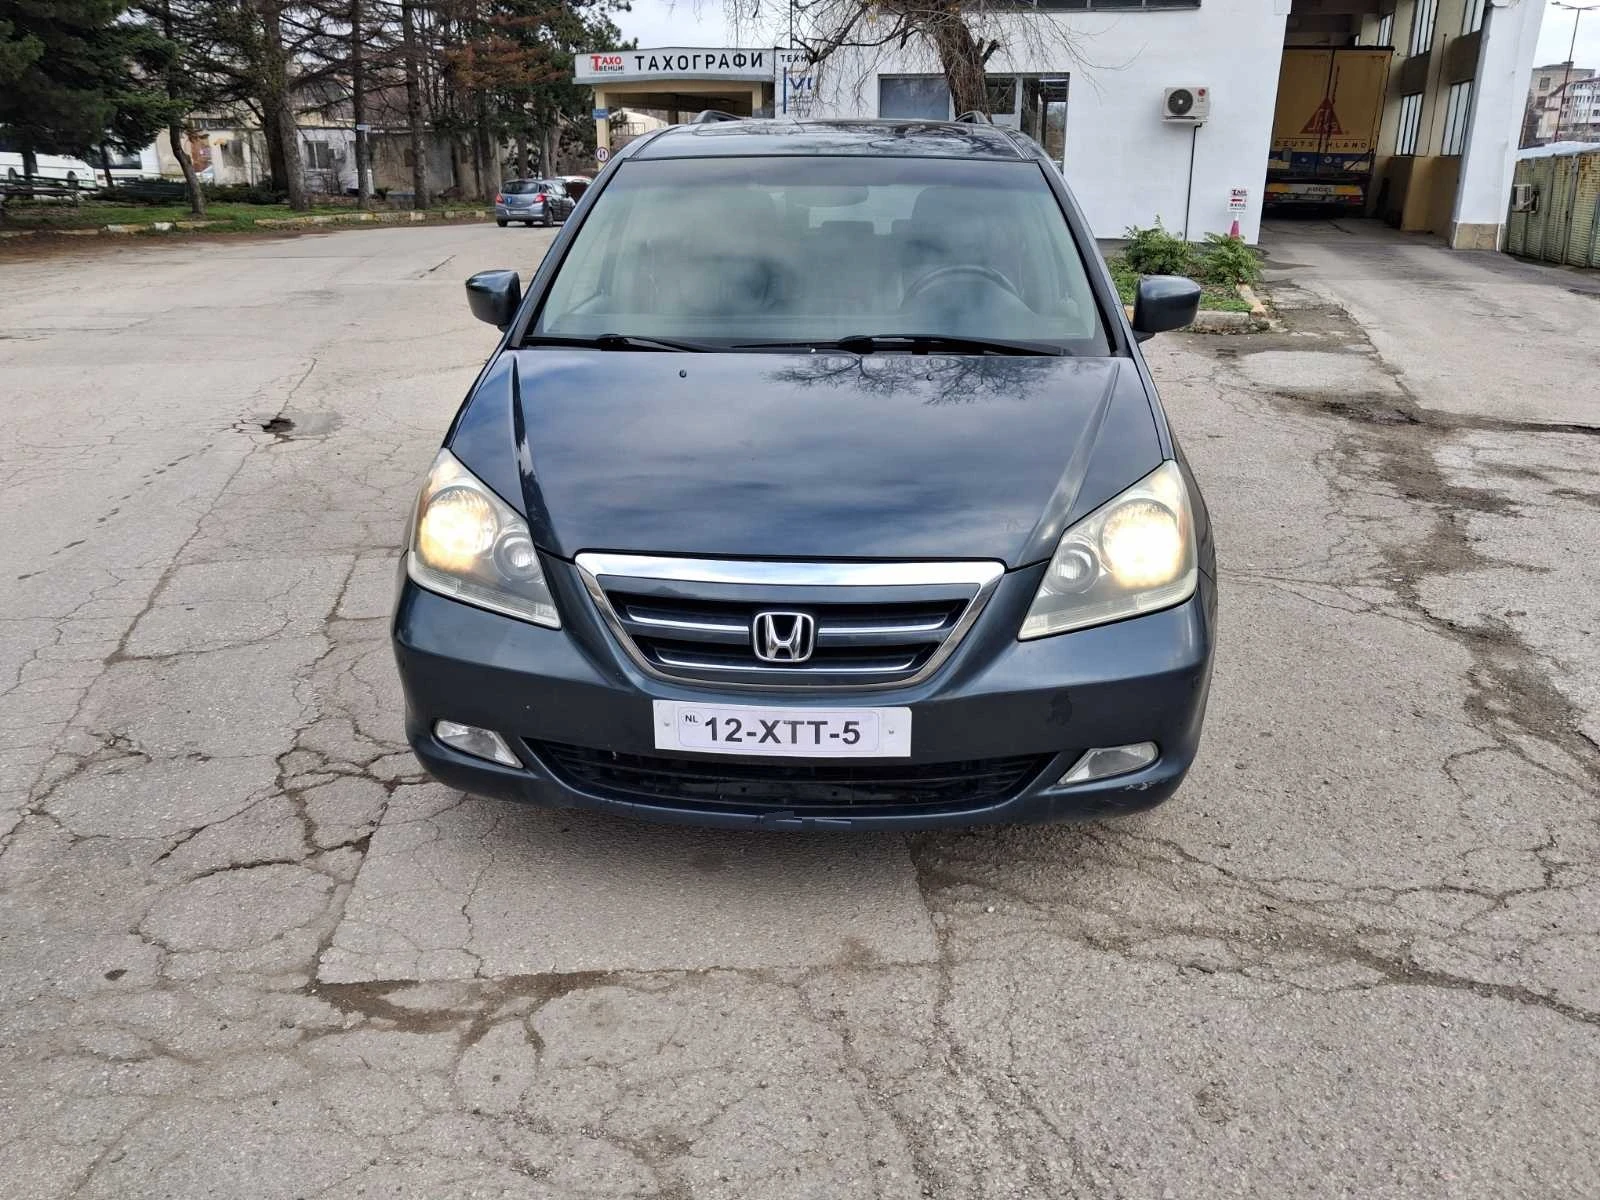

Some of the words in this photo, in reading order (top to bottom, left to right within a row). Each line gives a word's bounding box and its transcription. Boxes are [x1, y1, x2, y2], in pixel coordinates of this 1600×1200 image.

[634, 52, 763, 71] ТАХОГРАФИ
[1274, 140, 1368, 149] DEUTSHLAND
[684, 714, 699, 723] NL
[704, 716, 861, 745] 12-XTT-5
